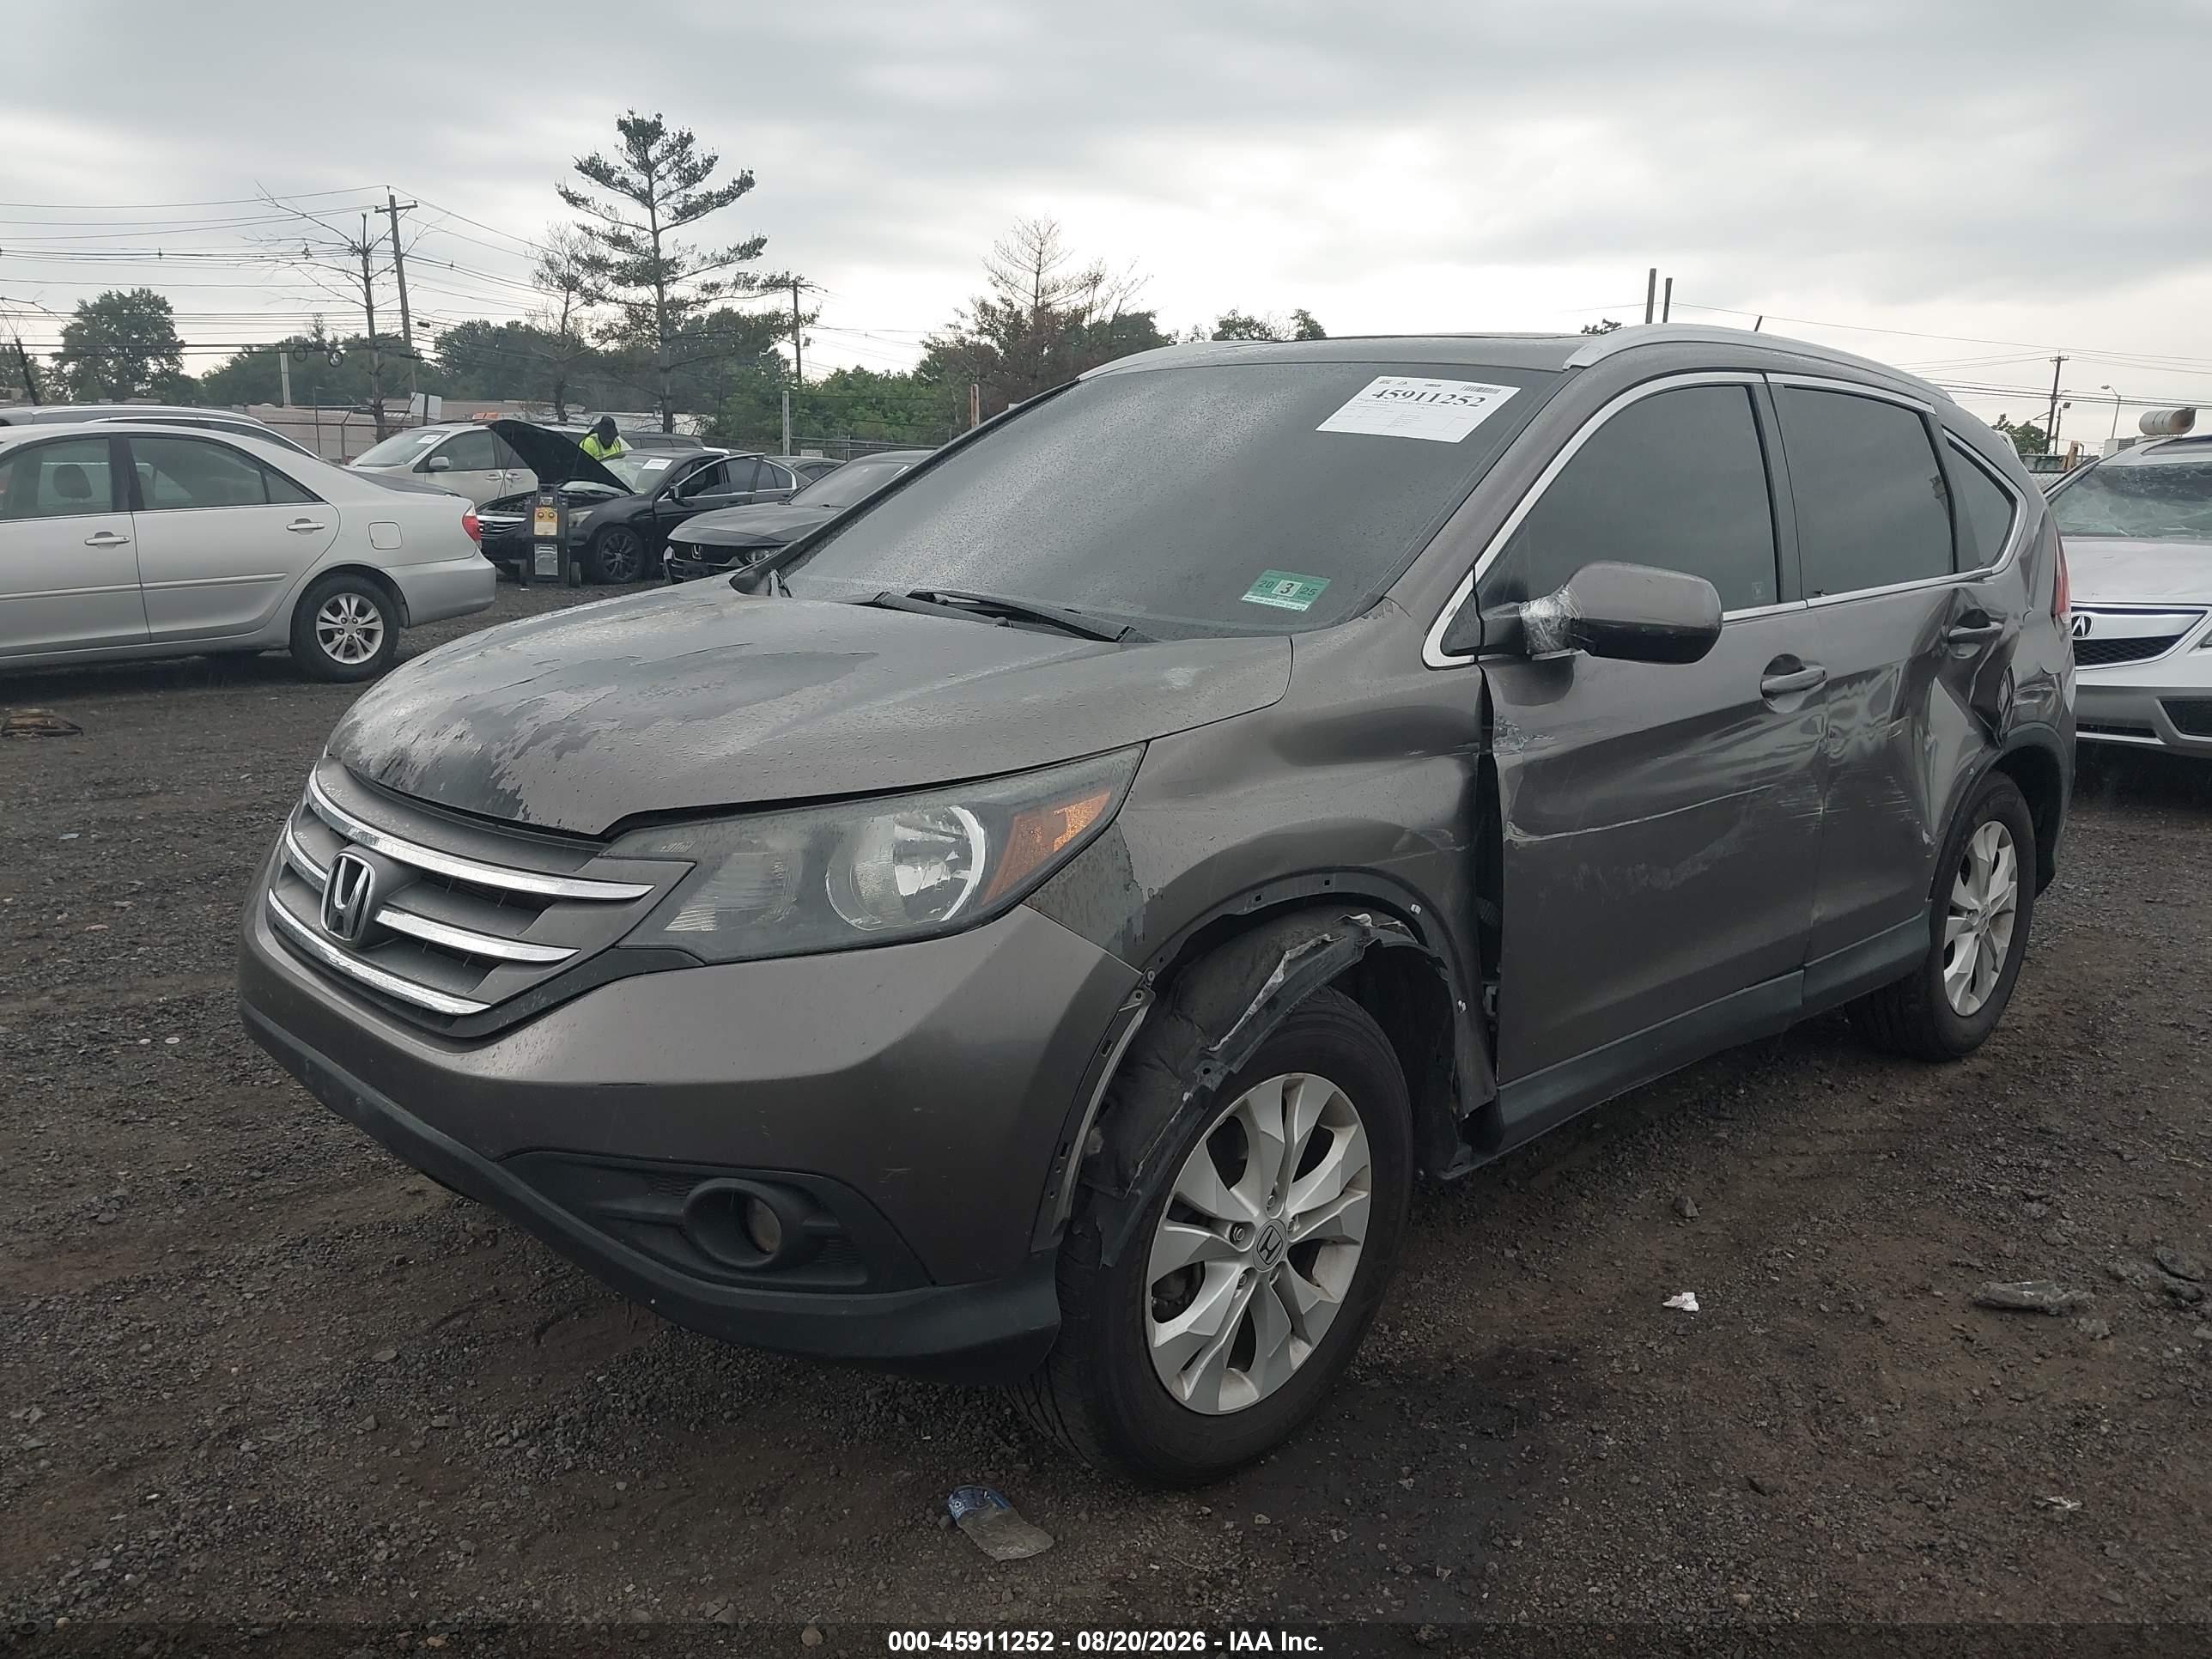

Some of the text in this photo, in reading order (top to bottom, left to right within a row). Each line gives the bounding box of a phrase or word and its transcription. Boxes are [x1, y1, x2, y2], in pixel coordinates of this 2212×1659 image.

[1371, 388, 1486, 408] 45911252
[1258, 580, 1274, 589] 20
[1280, 582, 1294, 594] 3
